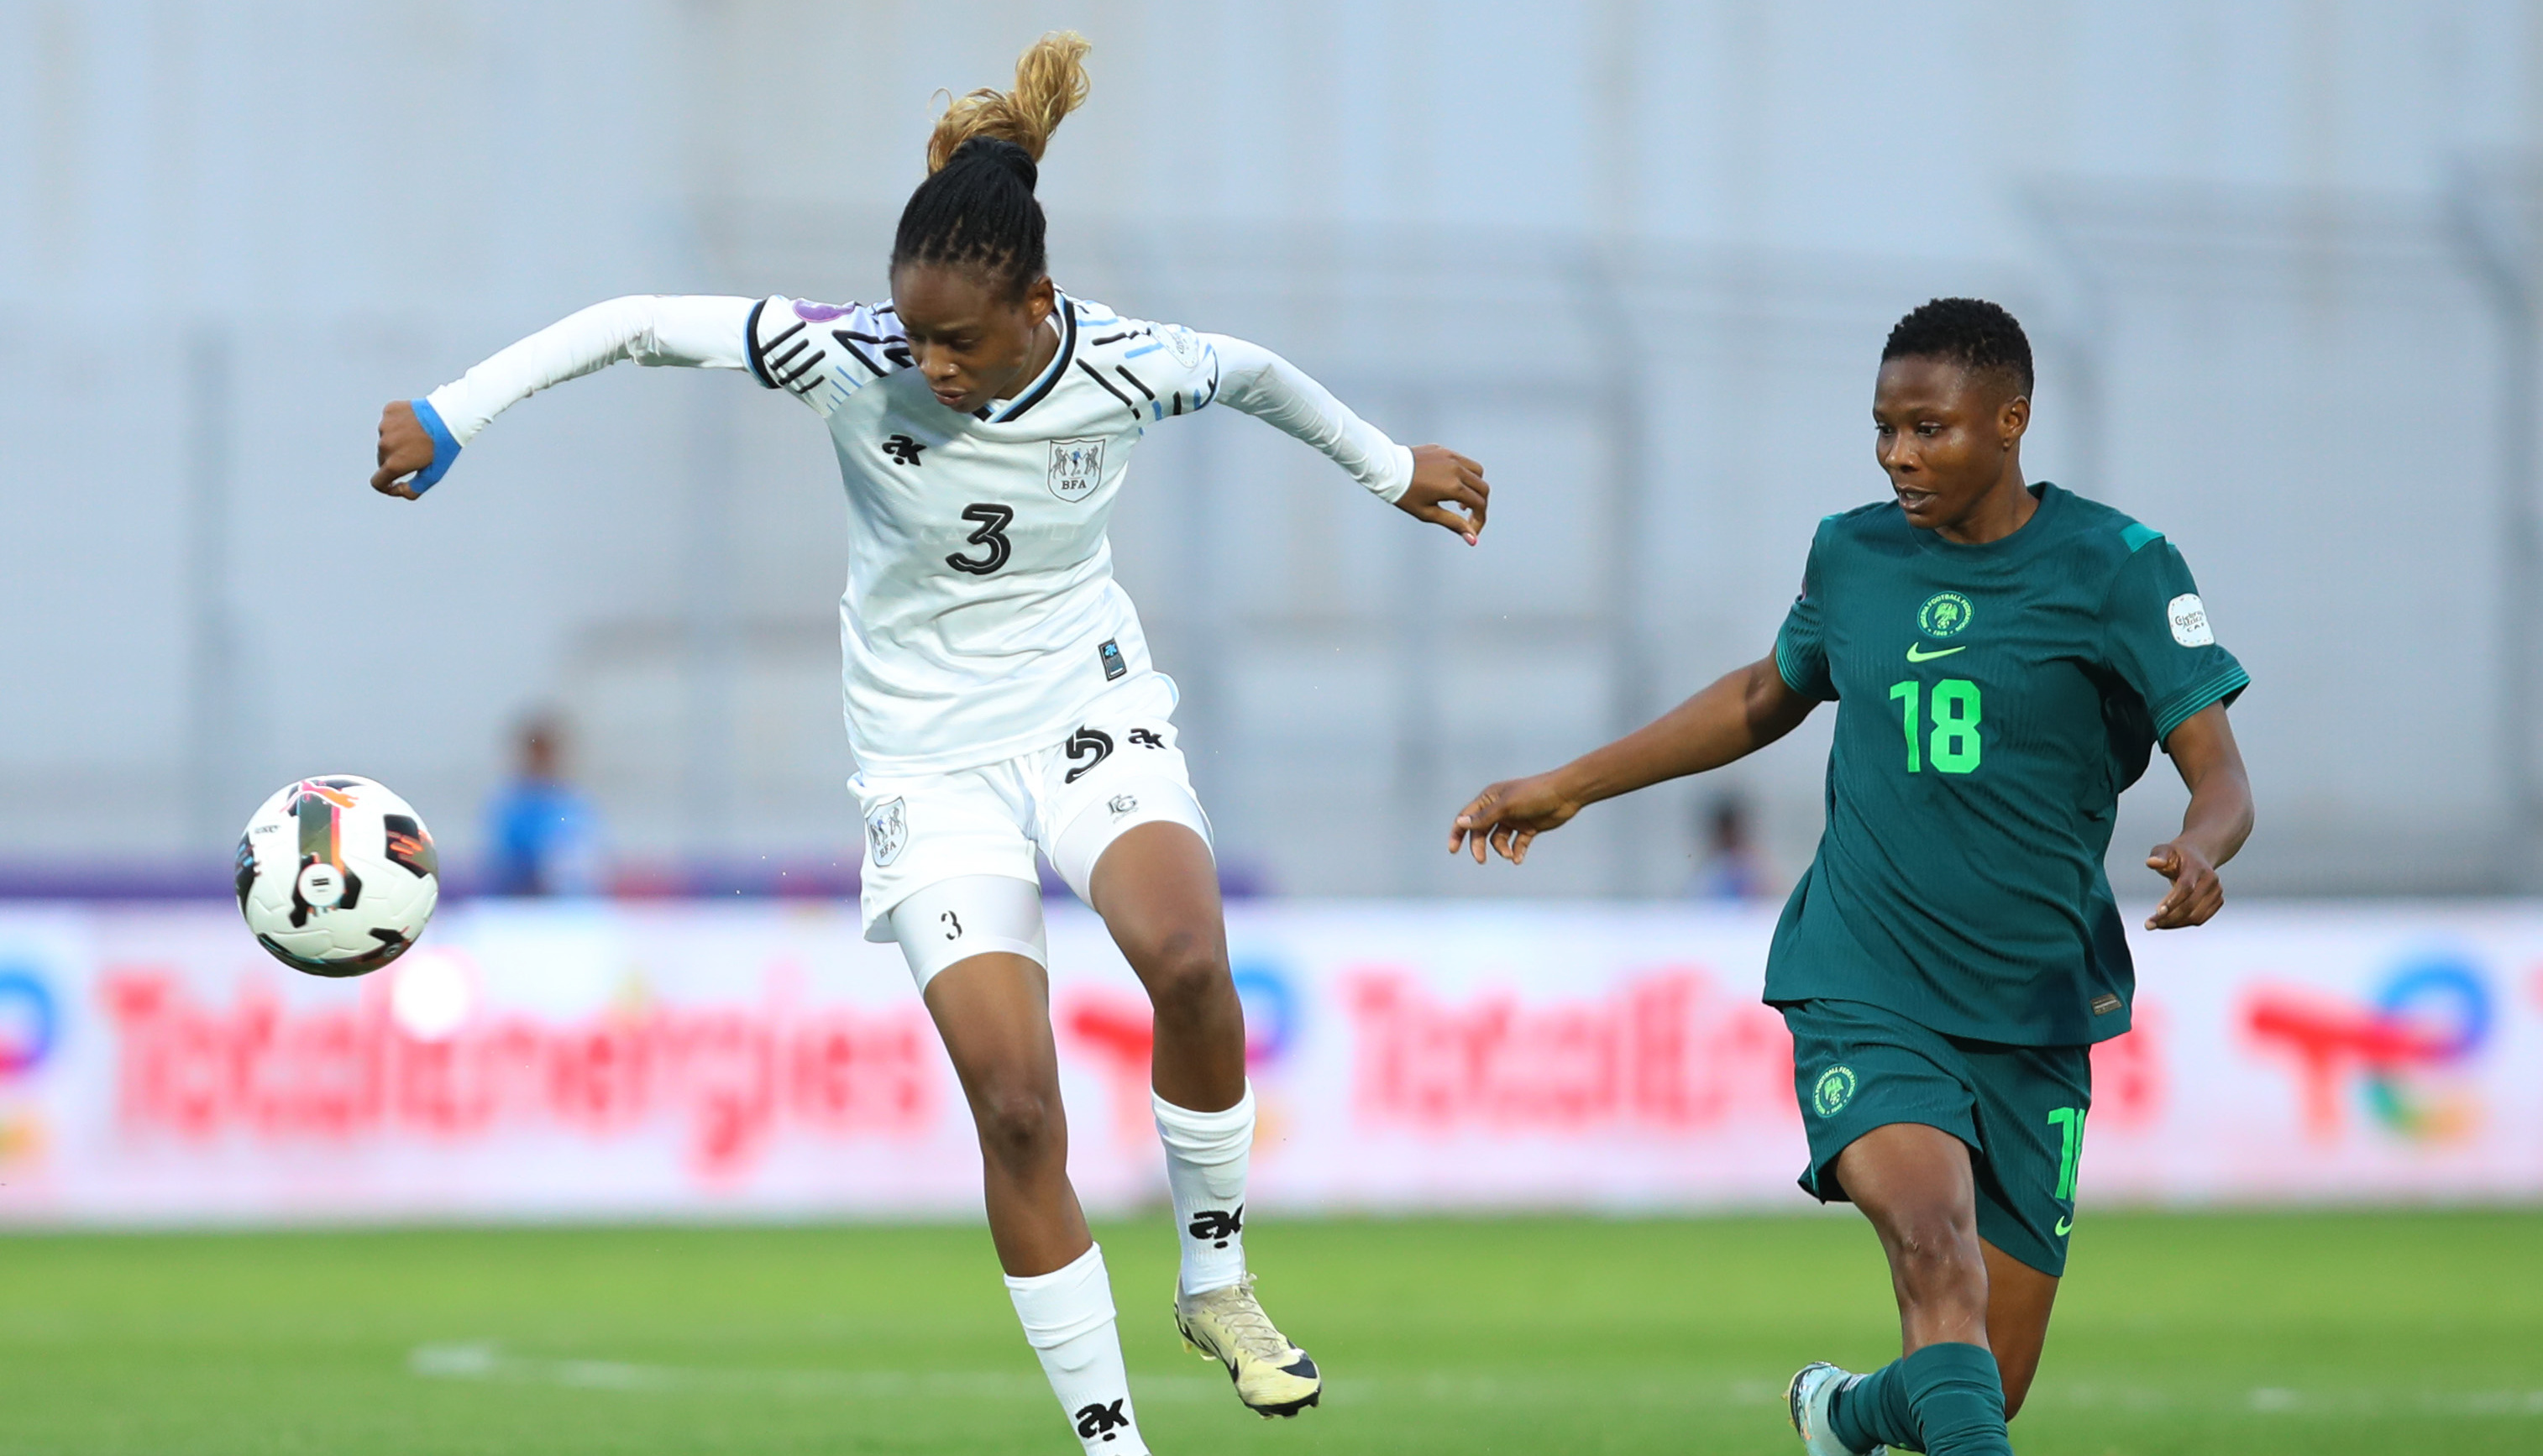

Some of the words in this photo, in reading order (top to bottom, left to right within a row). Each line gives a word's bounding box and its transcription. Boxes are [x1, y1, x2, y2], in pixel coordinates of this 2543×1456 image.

[1061, 479, 1087, 490] BFA
[946, 503, 1014, 575] 3
[1890, 678, 1981, 774] 18
[879, 841, 897, 858] BFA
[941, 910, 962, 940] 3
